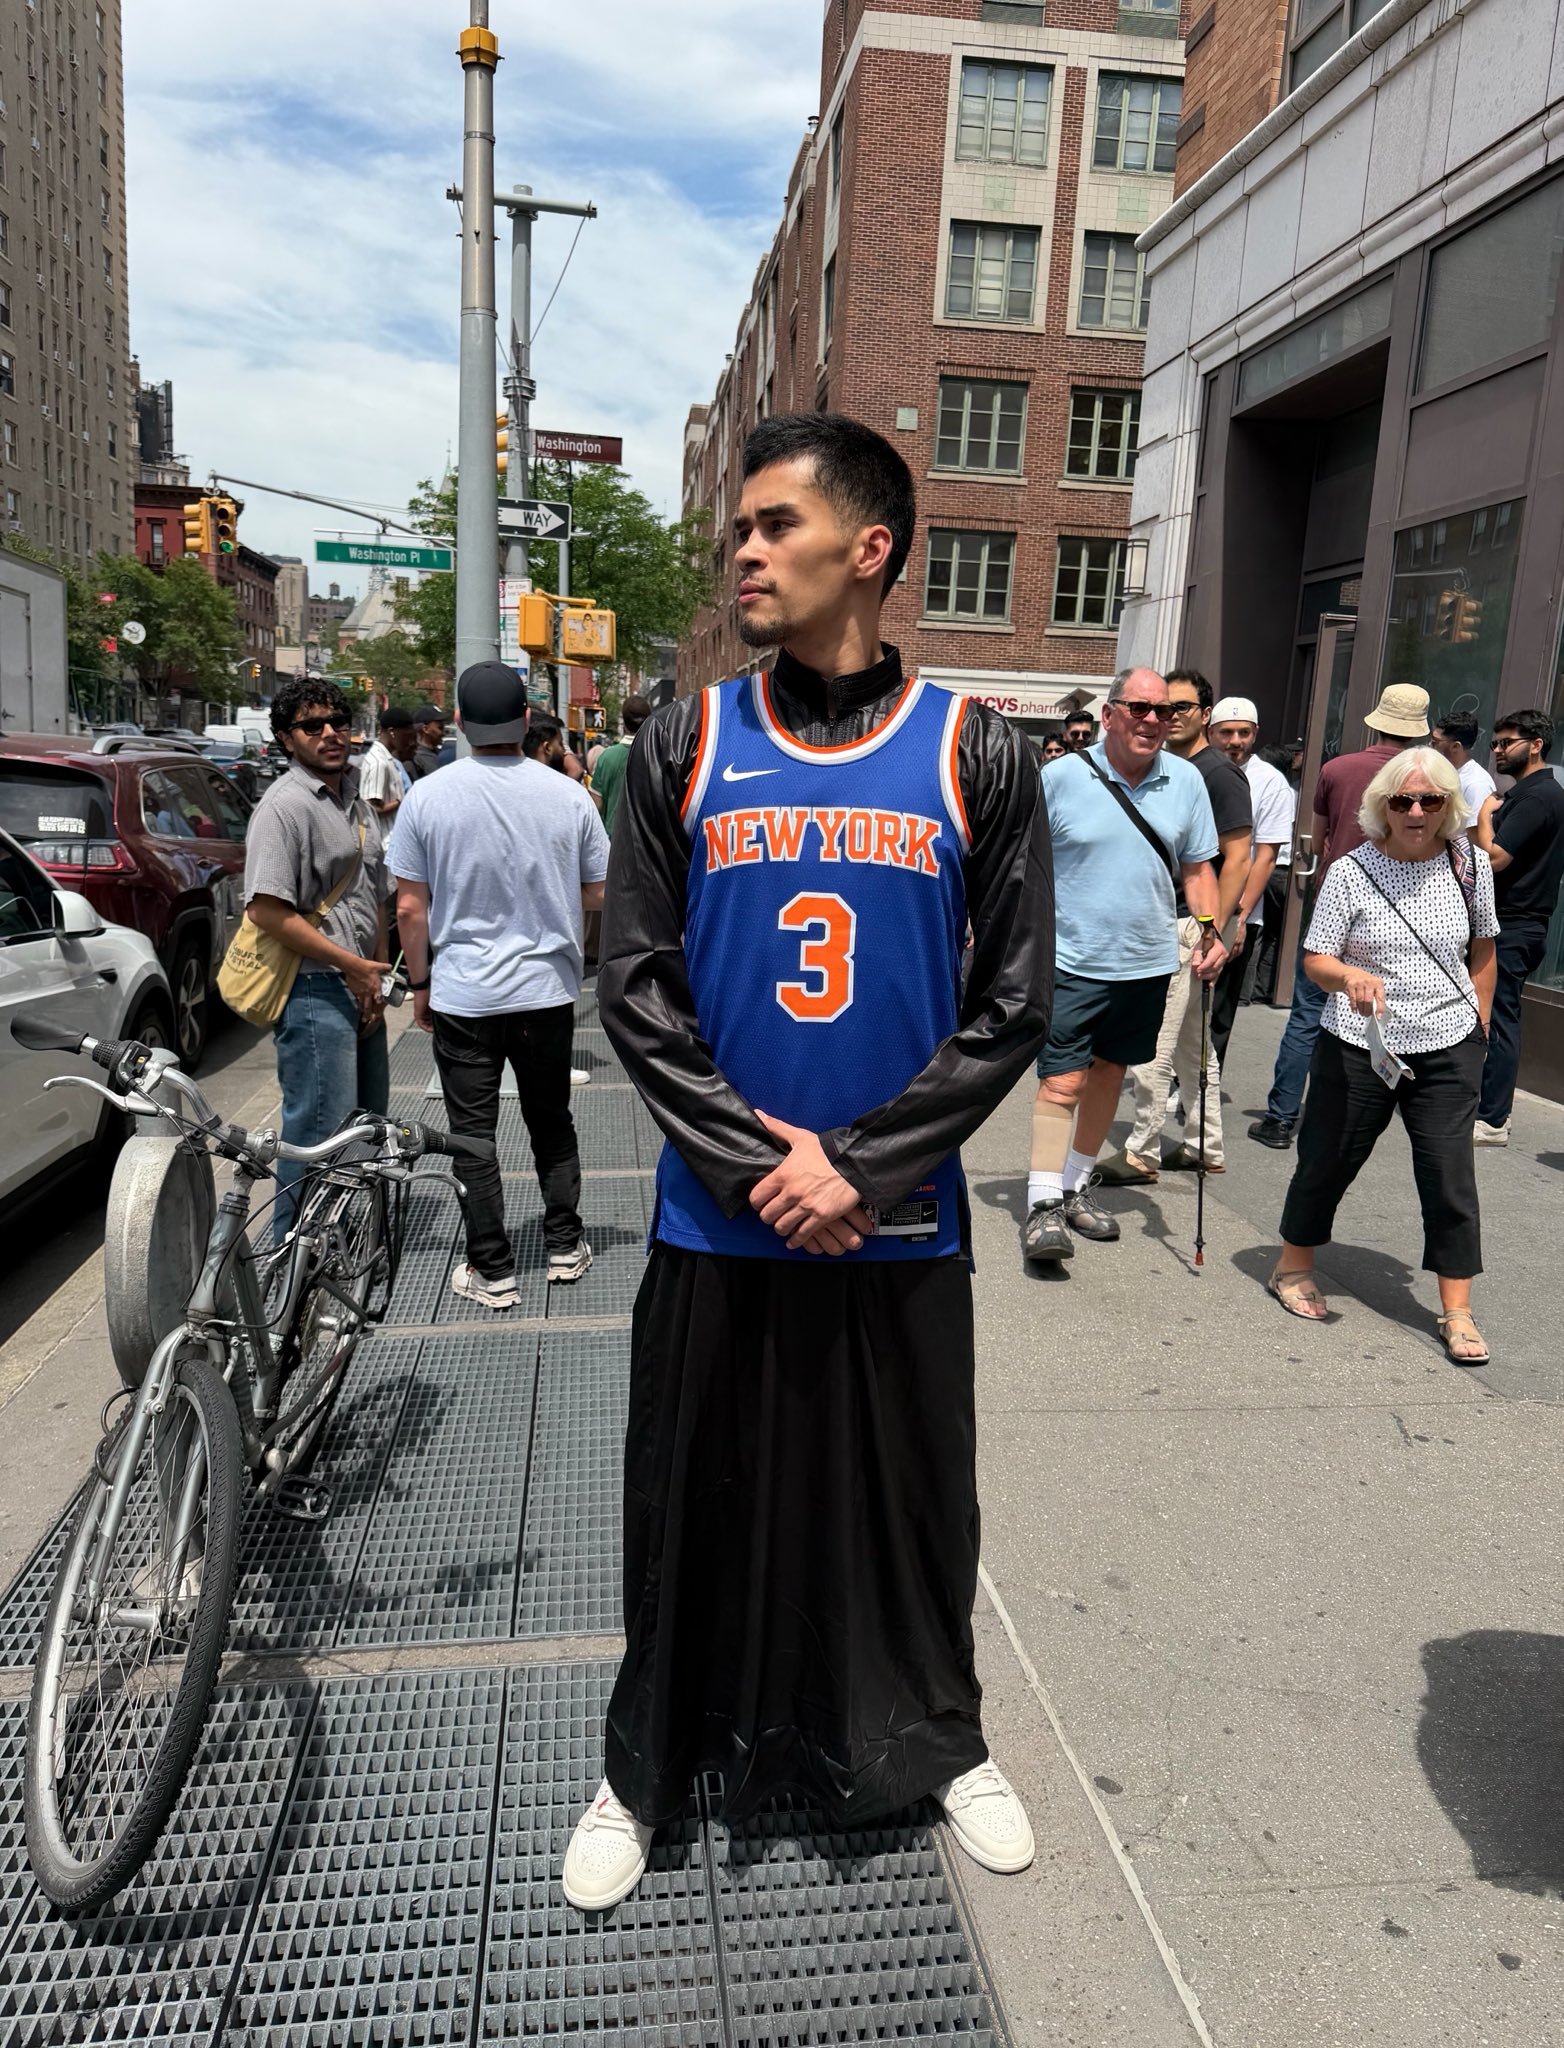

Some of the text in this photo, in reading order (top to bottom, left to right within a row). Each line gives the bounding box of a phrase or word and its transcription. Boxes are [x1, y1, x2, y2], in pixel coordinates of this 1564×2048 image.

[537, 435, 601, 456] Washington
[523, 511, 552, 527] WAY
[348, 546, 420, 565] Washington Pl
[984, 696, 1018, 712] CVS
[703, 806, 943, 879] NEW YORK
[776, 891, 857, 1023] 3
